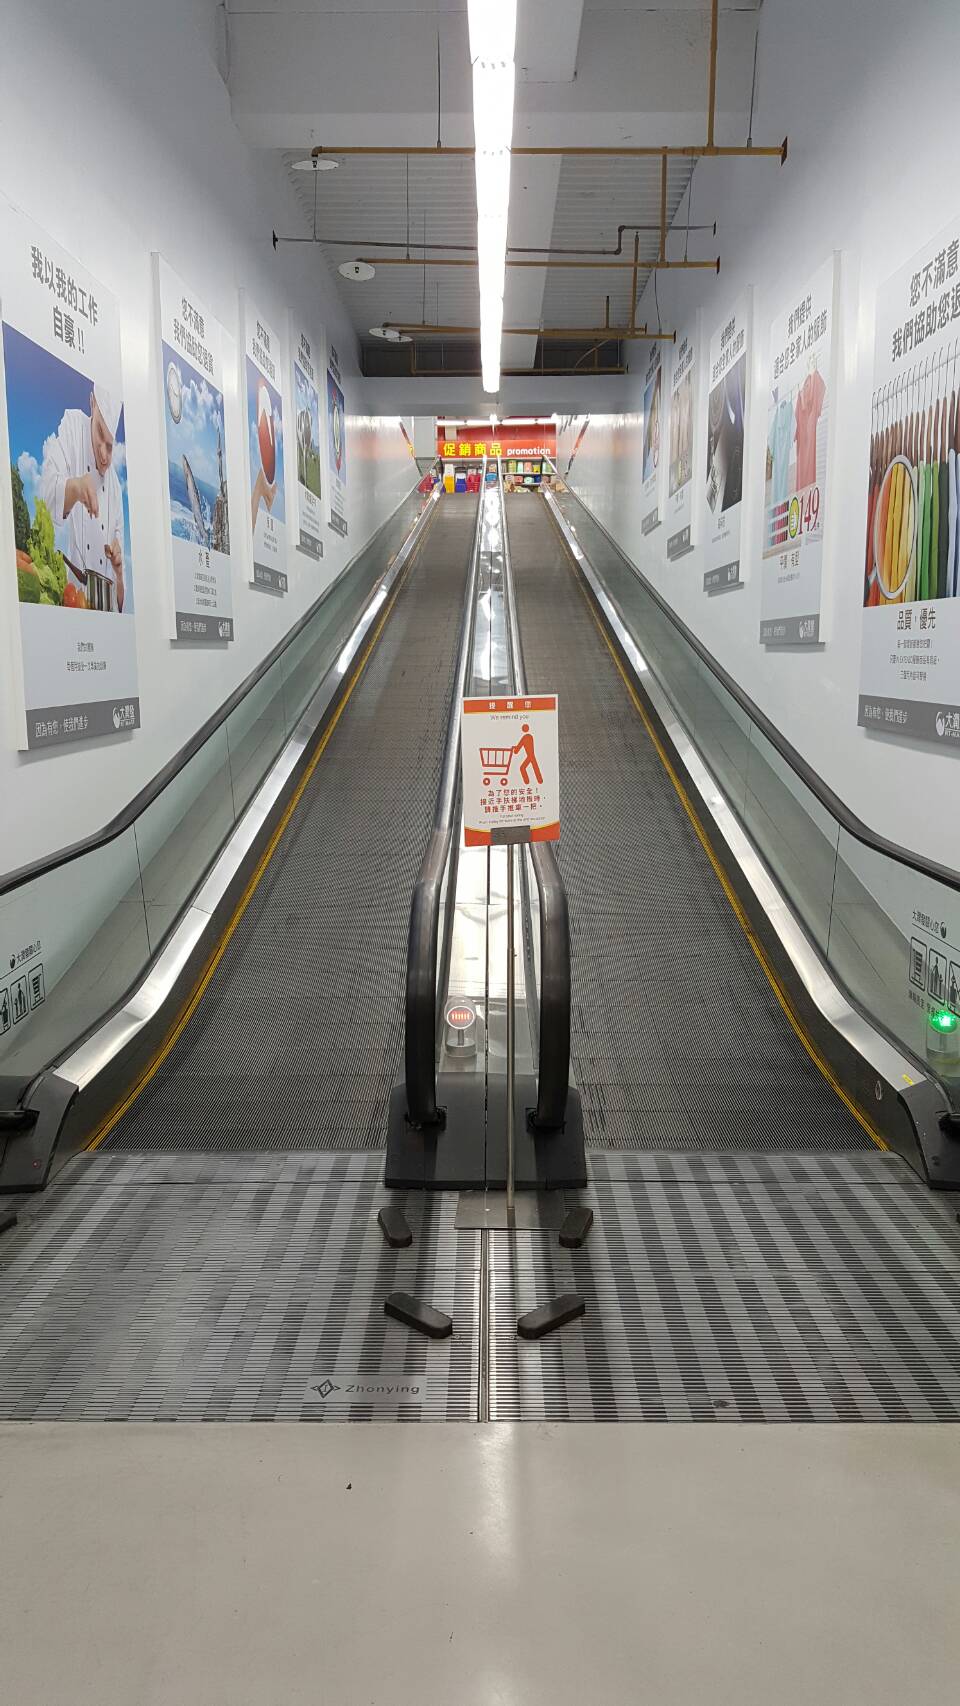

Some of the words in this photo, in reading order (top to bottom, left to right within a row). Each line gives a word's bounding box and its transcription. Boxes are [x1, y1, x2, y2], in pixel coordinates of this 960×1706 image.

[31, 245, 98, 326] 我以我的工作
[909, 239, 959, 307] 您不滿意
[444, 442, 502, 456] 促銷商品
[507, 447, 550, 458] promotion
[798, 487, 820, 535] 149
[345, 1385, 420, 1394] Zhonying
